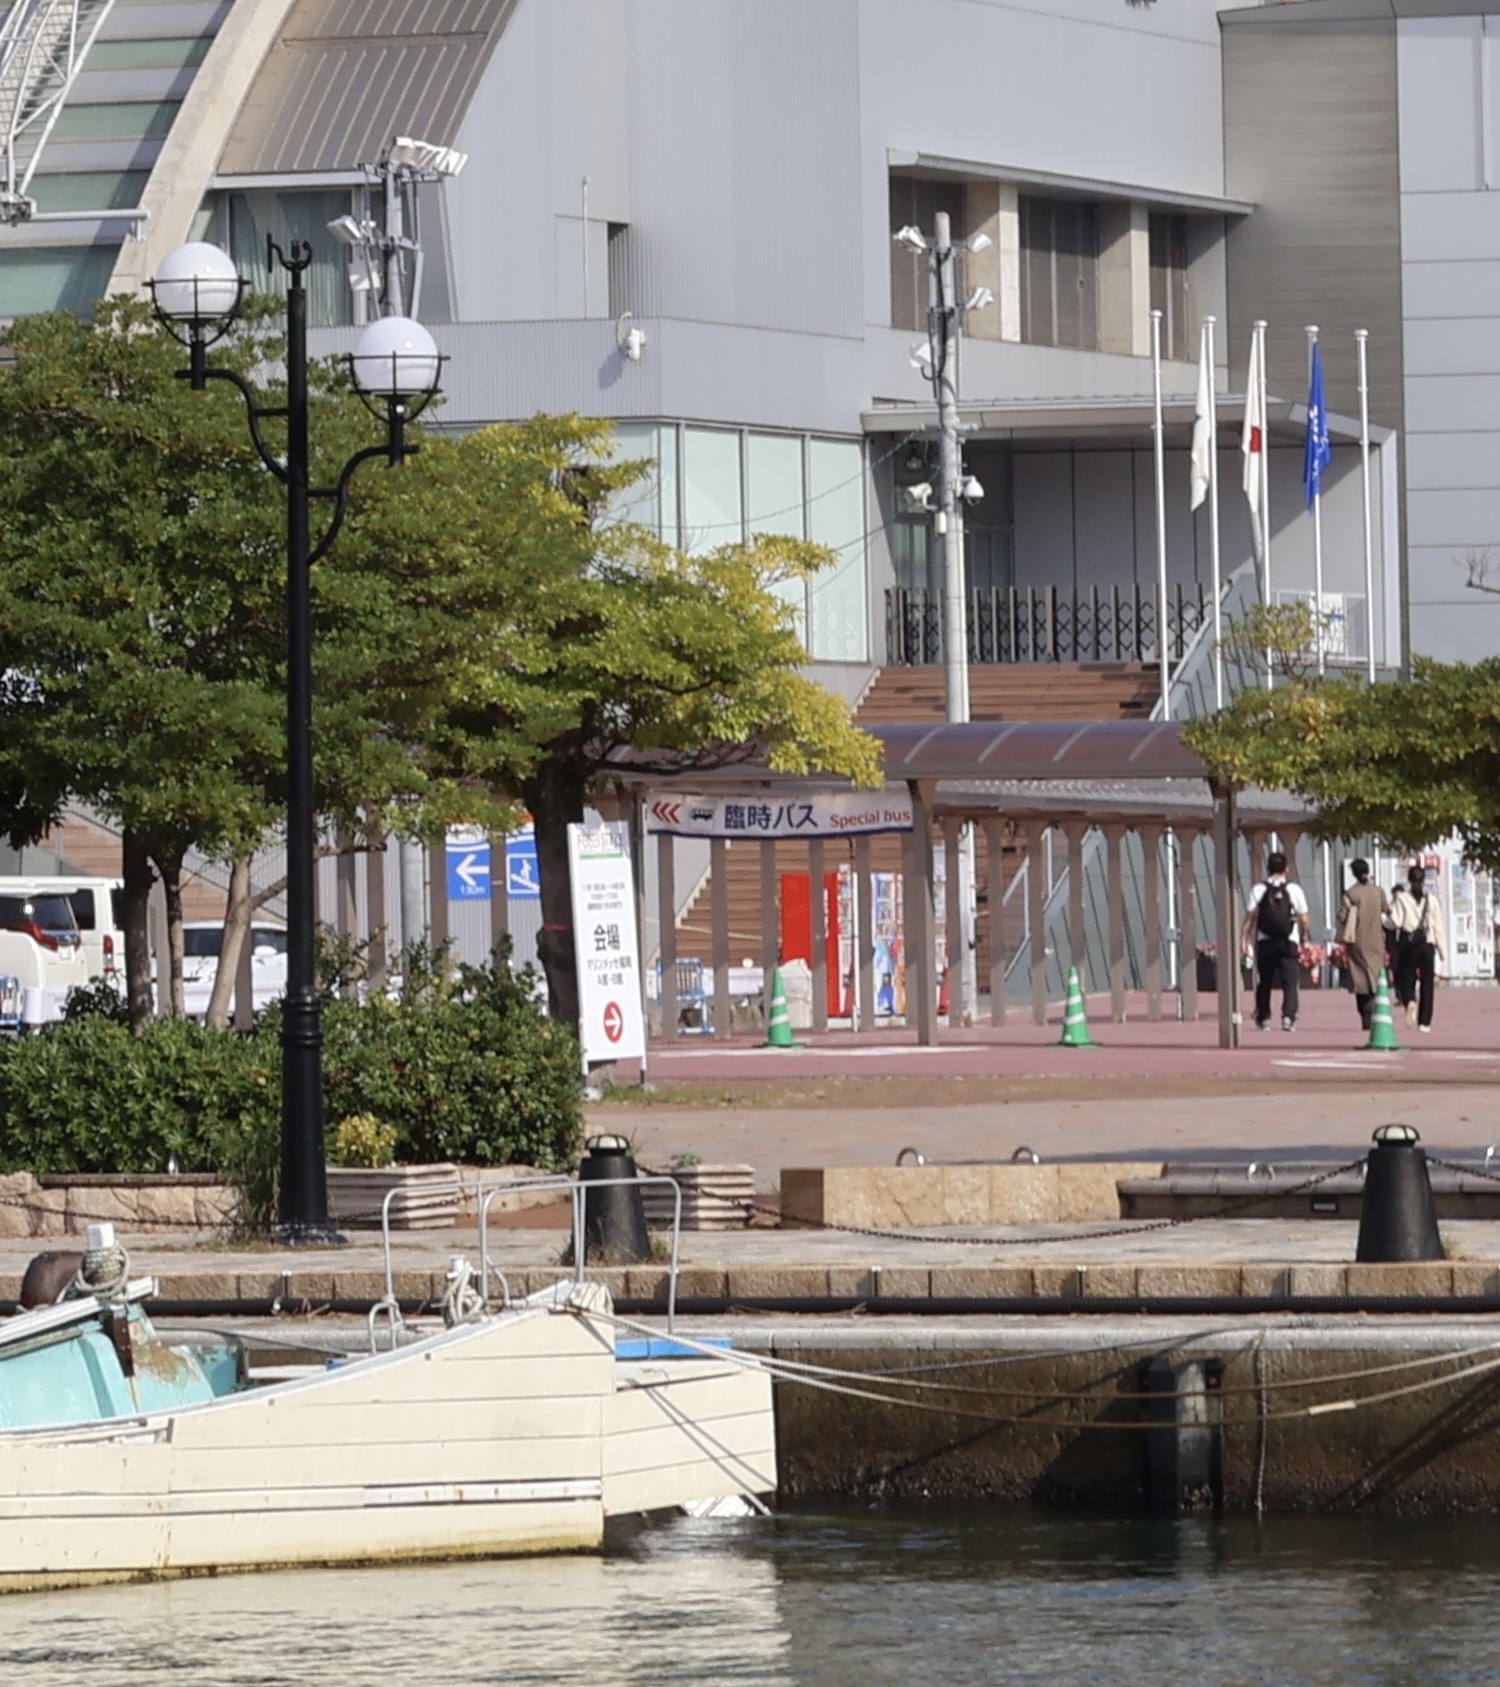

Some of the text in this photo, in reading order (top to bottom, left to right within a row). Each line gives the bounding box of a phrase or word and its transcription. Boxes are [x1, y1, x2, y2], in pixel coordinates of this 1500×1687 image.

[724, 804, 911, 829] 臨時バス Special bus
[594, 923, 620, 951] 会場
